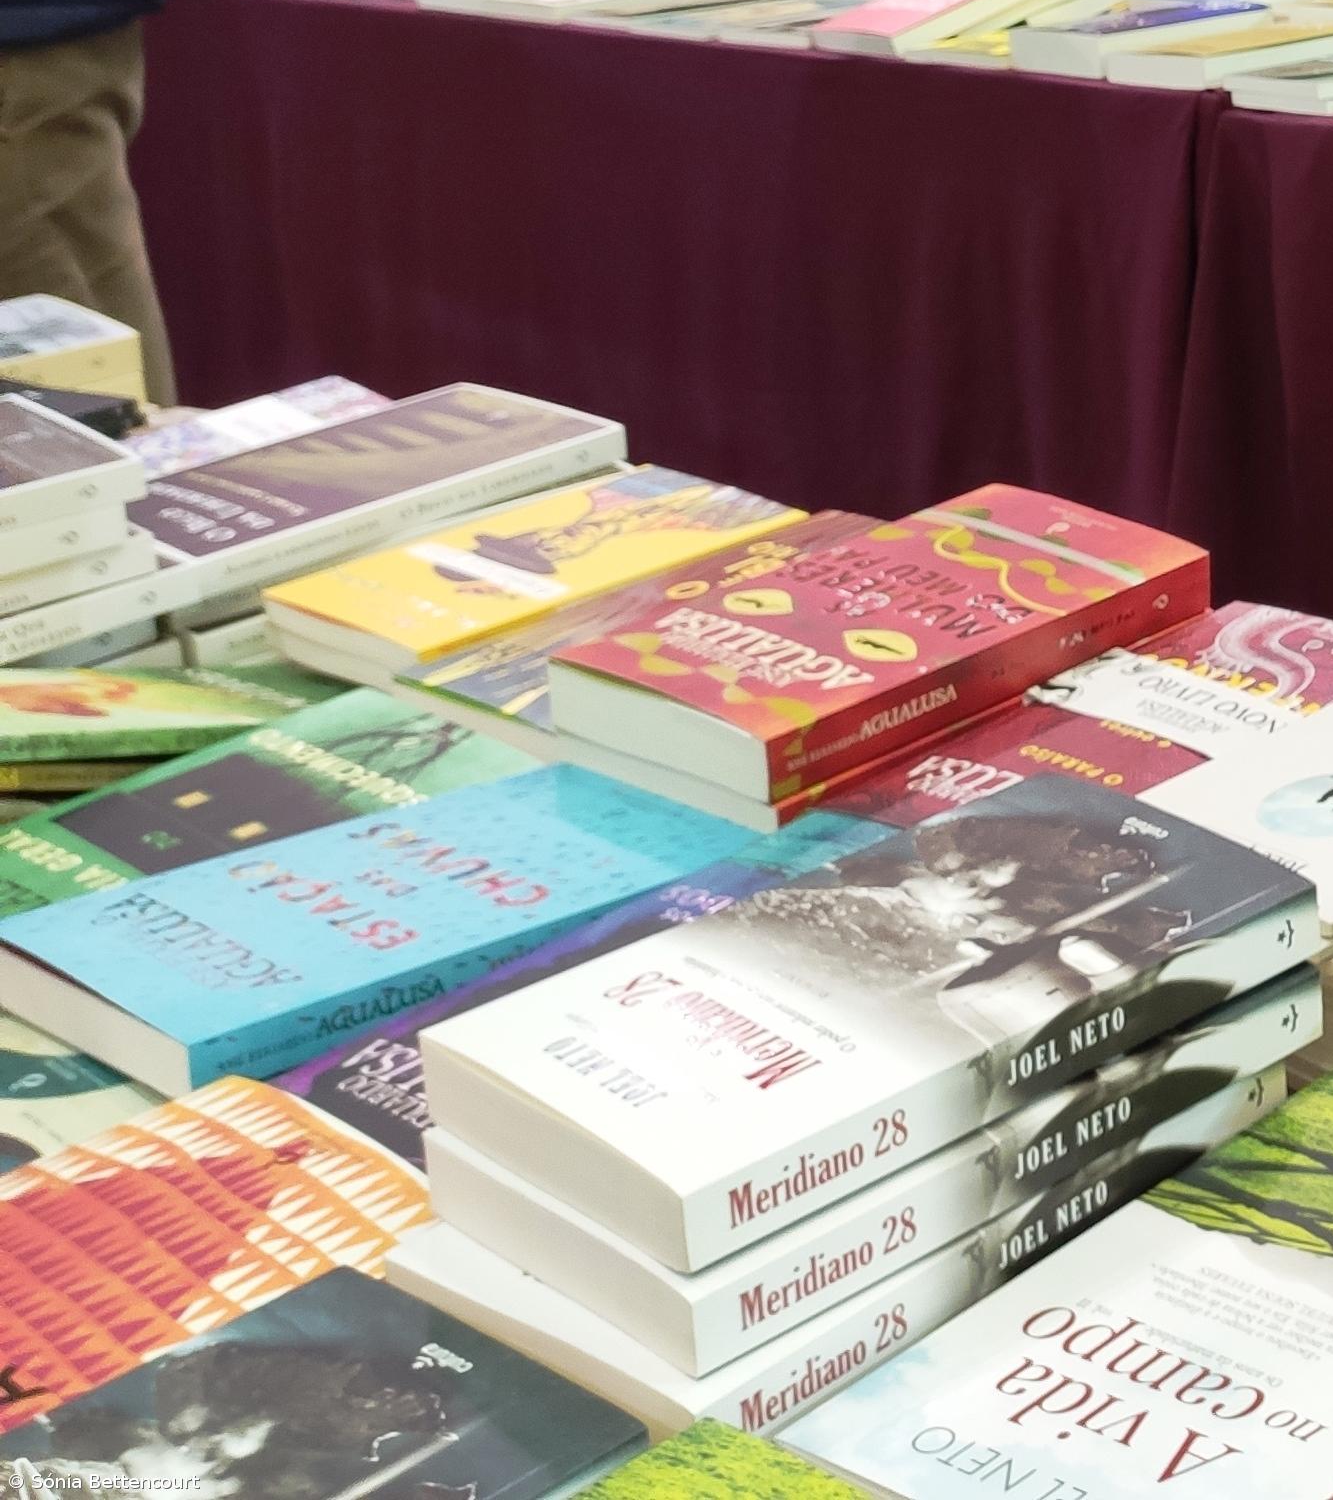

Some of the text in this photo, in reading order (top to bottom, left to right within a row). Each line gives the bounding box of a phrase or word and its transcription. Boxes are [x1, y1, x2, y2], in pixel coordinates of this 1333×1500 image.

[654, 606, 876, 691] AGUALUSA
[859, 683, 958, 742] AGUALUSA
[1137, 675, 1217, 709] LIVRO
[1019, 744, 1105, 780] PARAÍSO
[228, 859, 420, 952] ESTAÇÃO
[348, 822, 551, 909] CHUVAS
[314, 974, 447, 1041] AGUALUSA
[602, 970, 684, 1008] 28
[543, 1035, 669, 1108] JOEL NETO
[667, 990, 823, 1090] Meridiano
[728, 1006, 1126, 1229] Meridiano 28 JOEL NETO
[738, 1096, 1132, 1331] Meridiano 28 JOEL NETO
[739, 1180, 1109, 1436] Meridiano 28 JOEL NETO
[1021, 1305, 1266, 1421] campo
[910, 1424, 1037, 1493] NETO
[995, 1357, 1244, 1484] A vida
[1264, 1408, 1329, 1442] no
